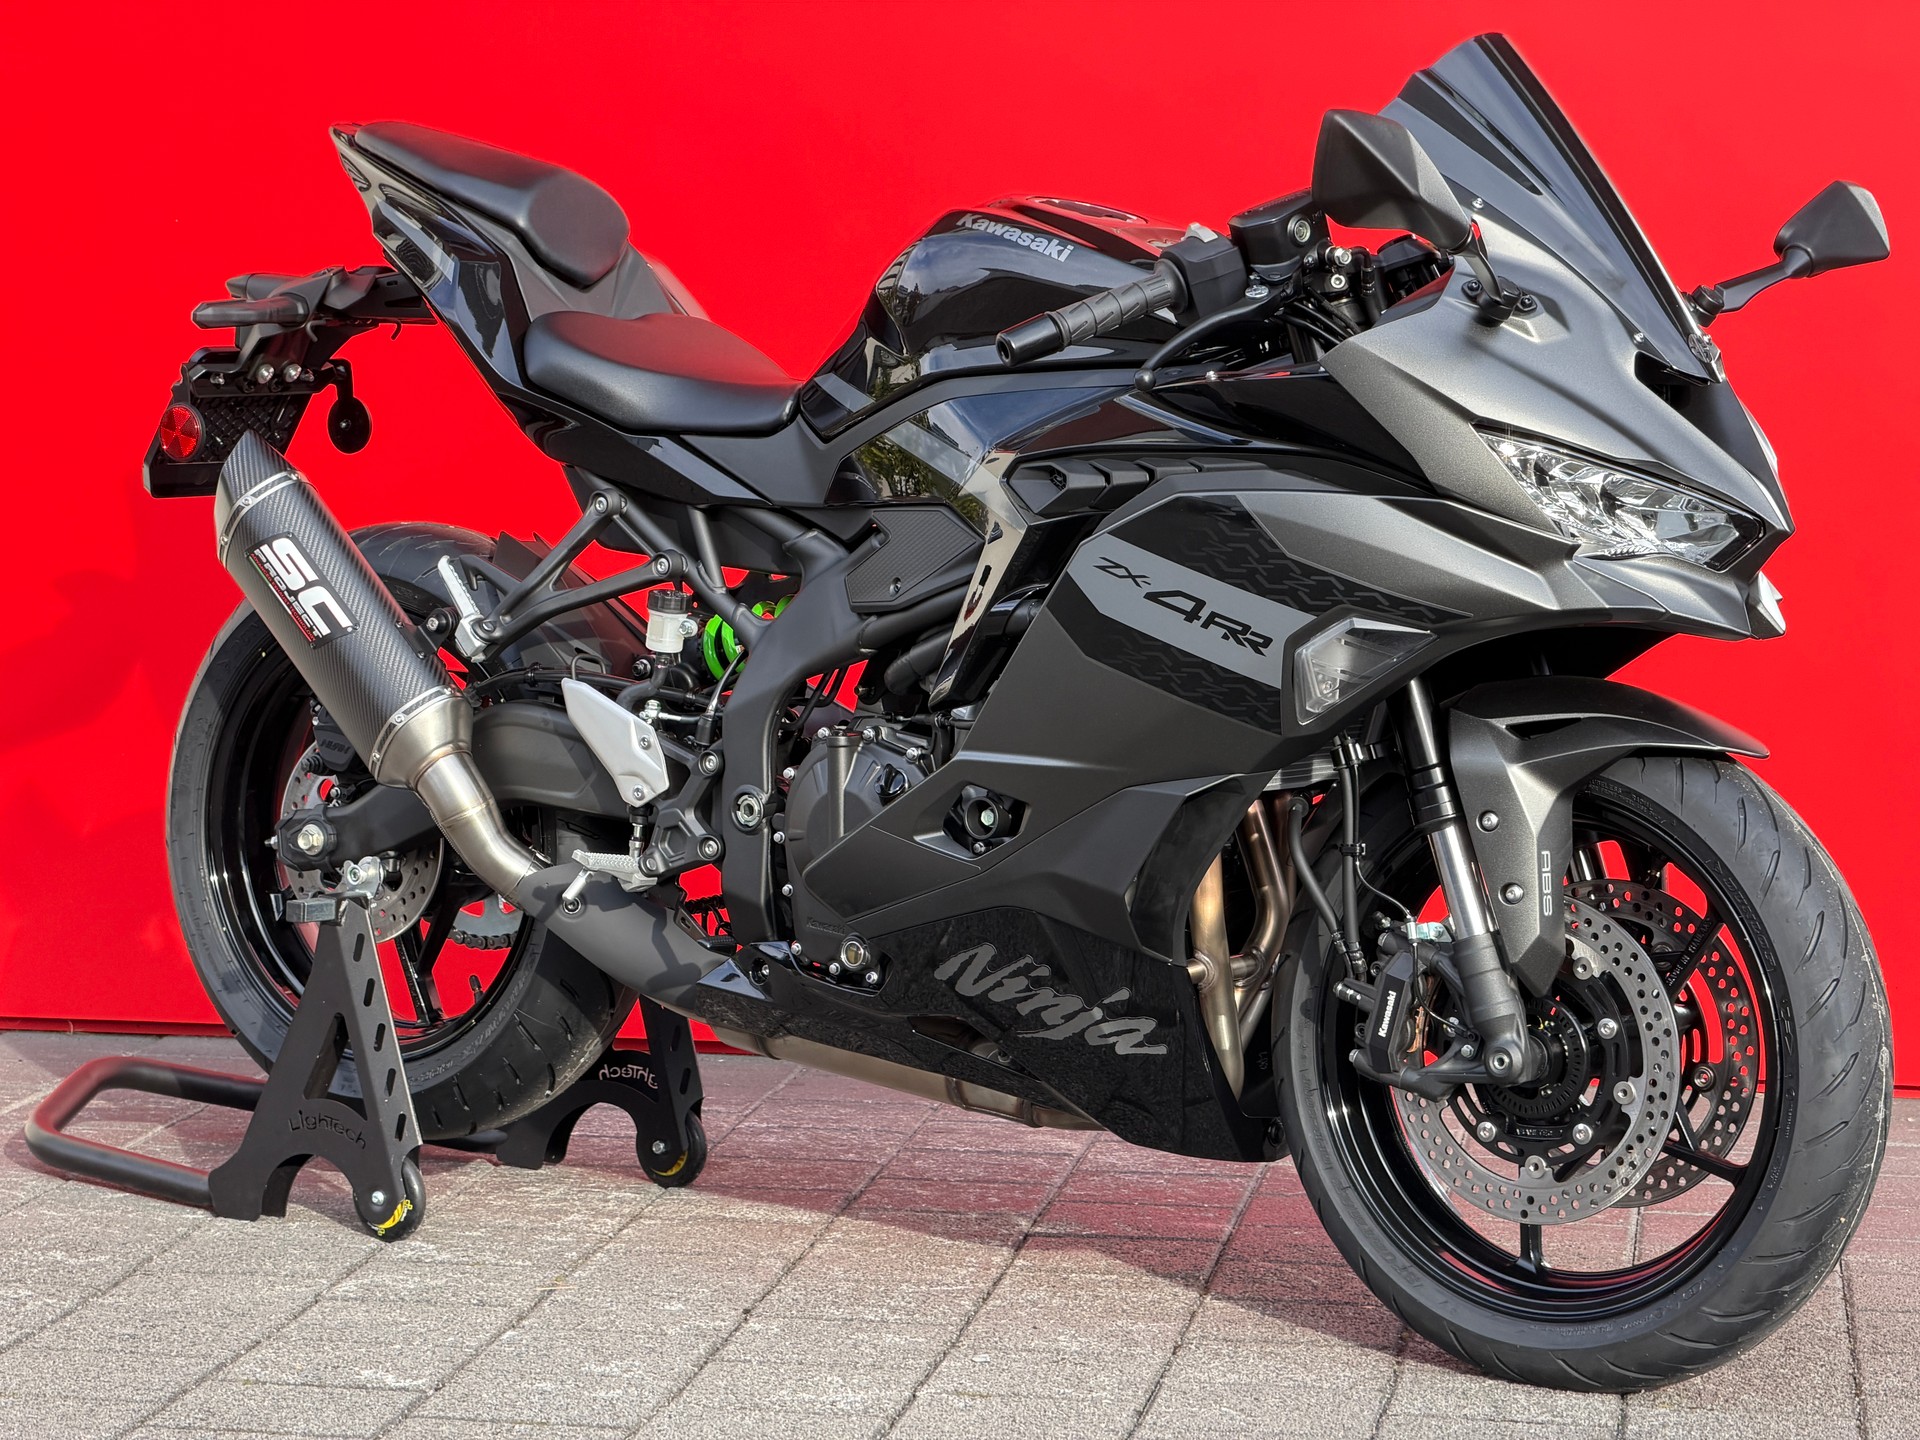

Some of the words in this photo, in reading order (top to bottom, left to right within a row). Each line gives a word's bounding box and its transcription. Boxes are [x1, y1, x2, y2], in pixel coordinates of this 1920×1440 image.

[956, 213, 1075, 262] Kawasaki
[253, 548, 323, 639] PROJECT
[259, 537, 353, 636] SC
[1541, 850, 1553, 916] ABS
[934, 942, 1168, 1055] Ninja
[1378, 990, 1396, 1038] Kawasaki
[288, 1109, 366, 1150] LighTech
